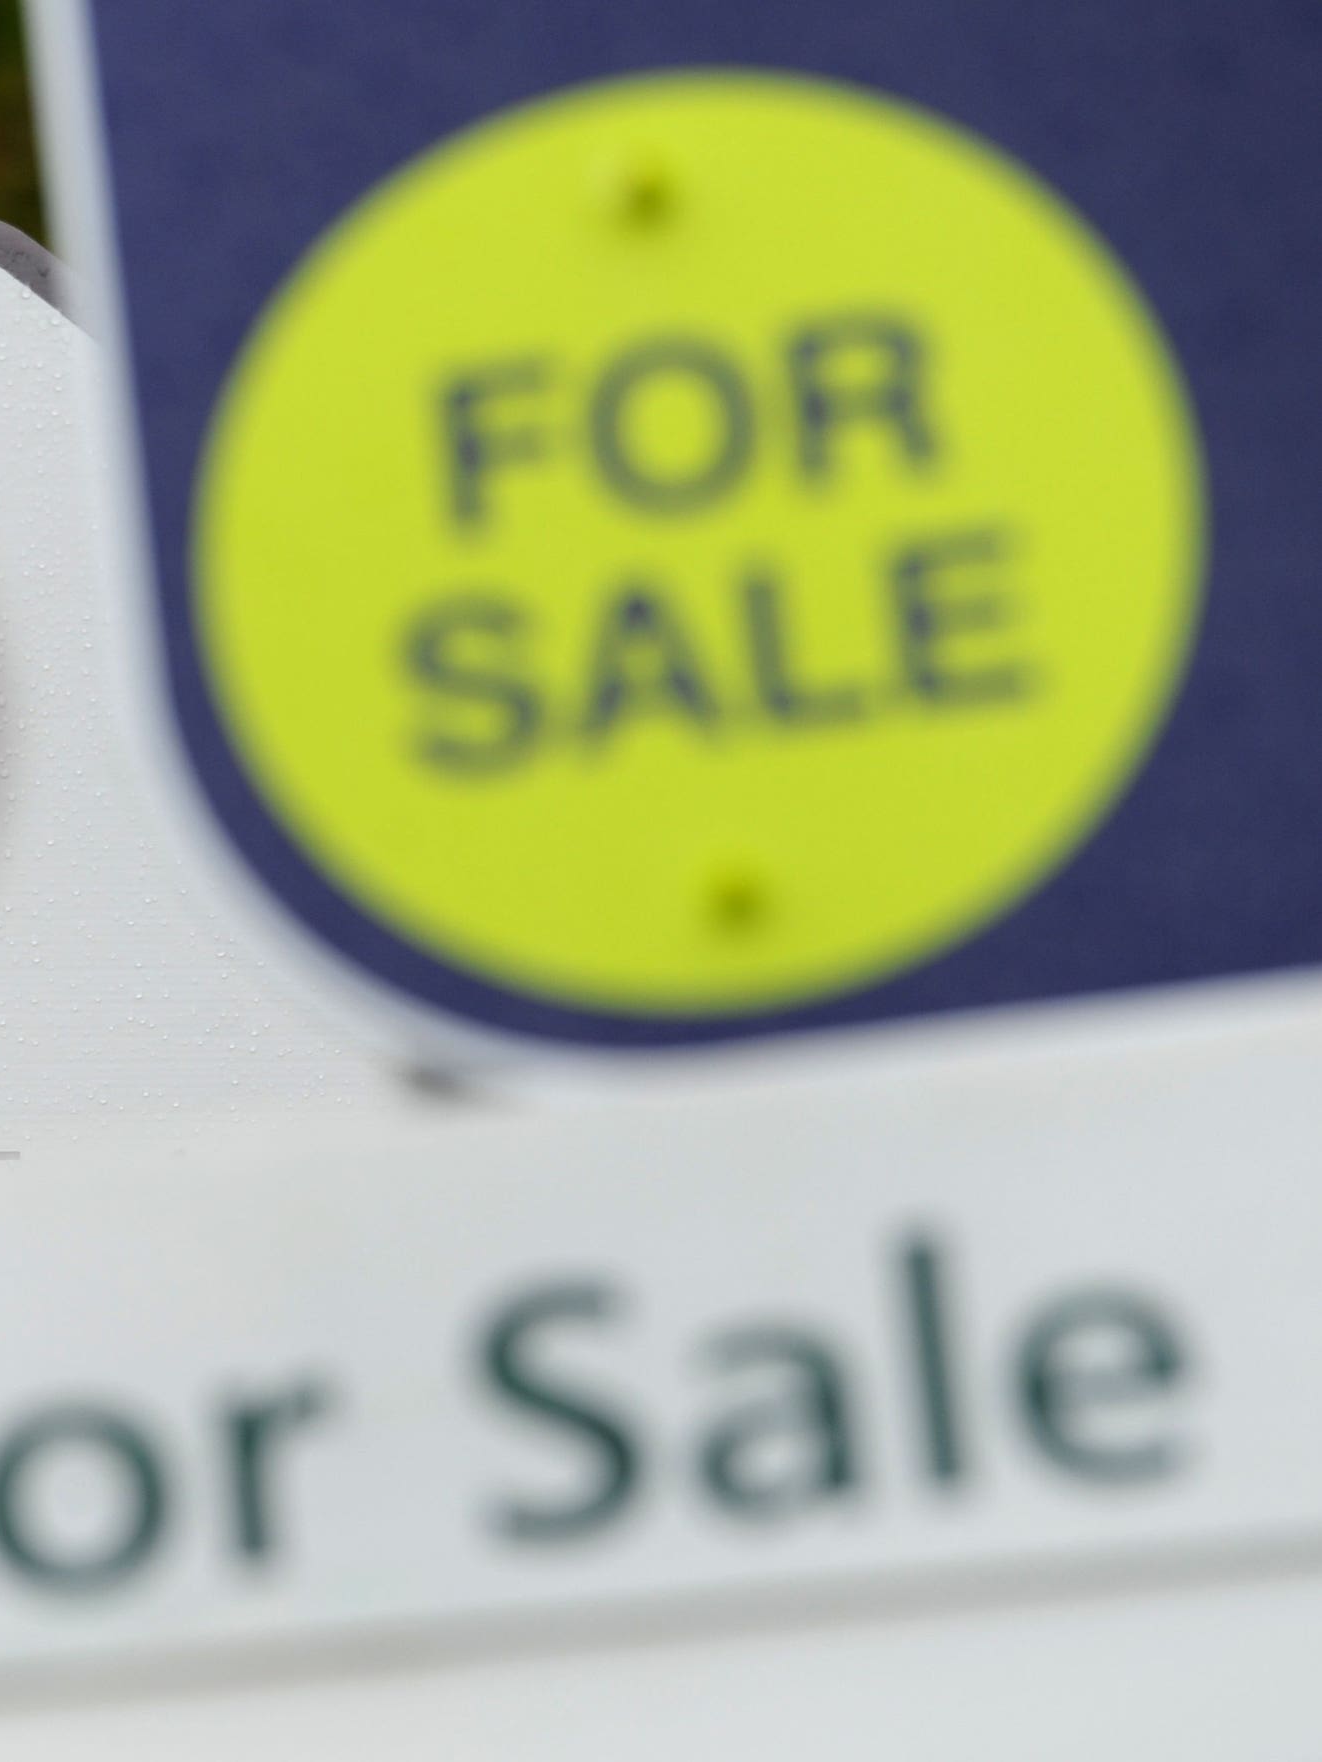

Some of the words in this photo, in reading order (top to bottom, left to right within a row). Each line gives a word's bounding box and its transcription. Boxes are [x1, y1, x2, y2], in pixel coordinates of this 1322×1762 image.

[435, 310, 940, 537] FOR
[400, 524, 1042, 780] SALE
[468, 1232, 1192, 1546] Sale
